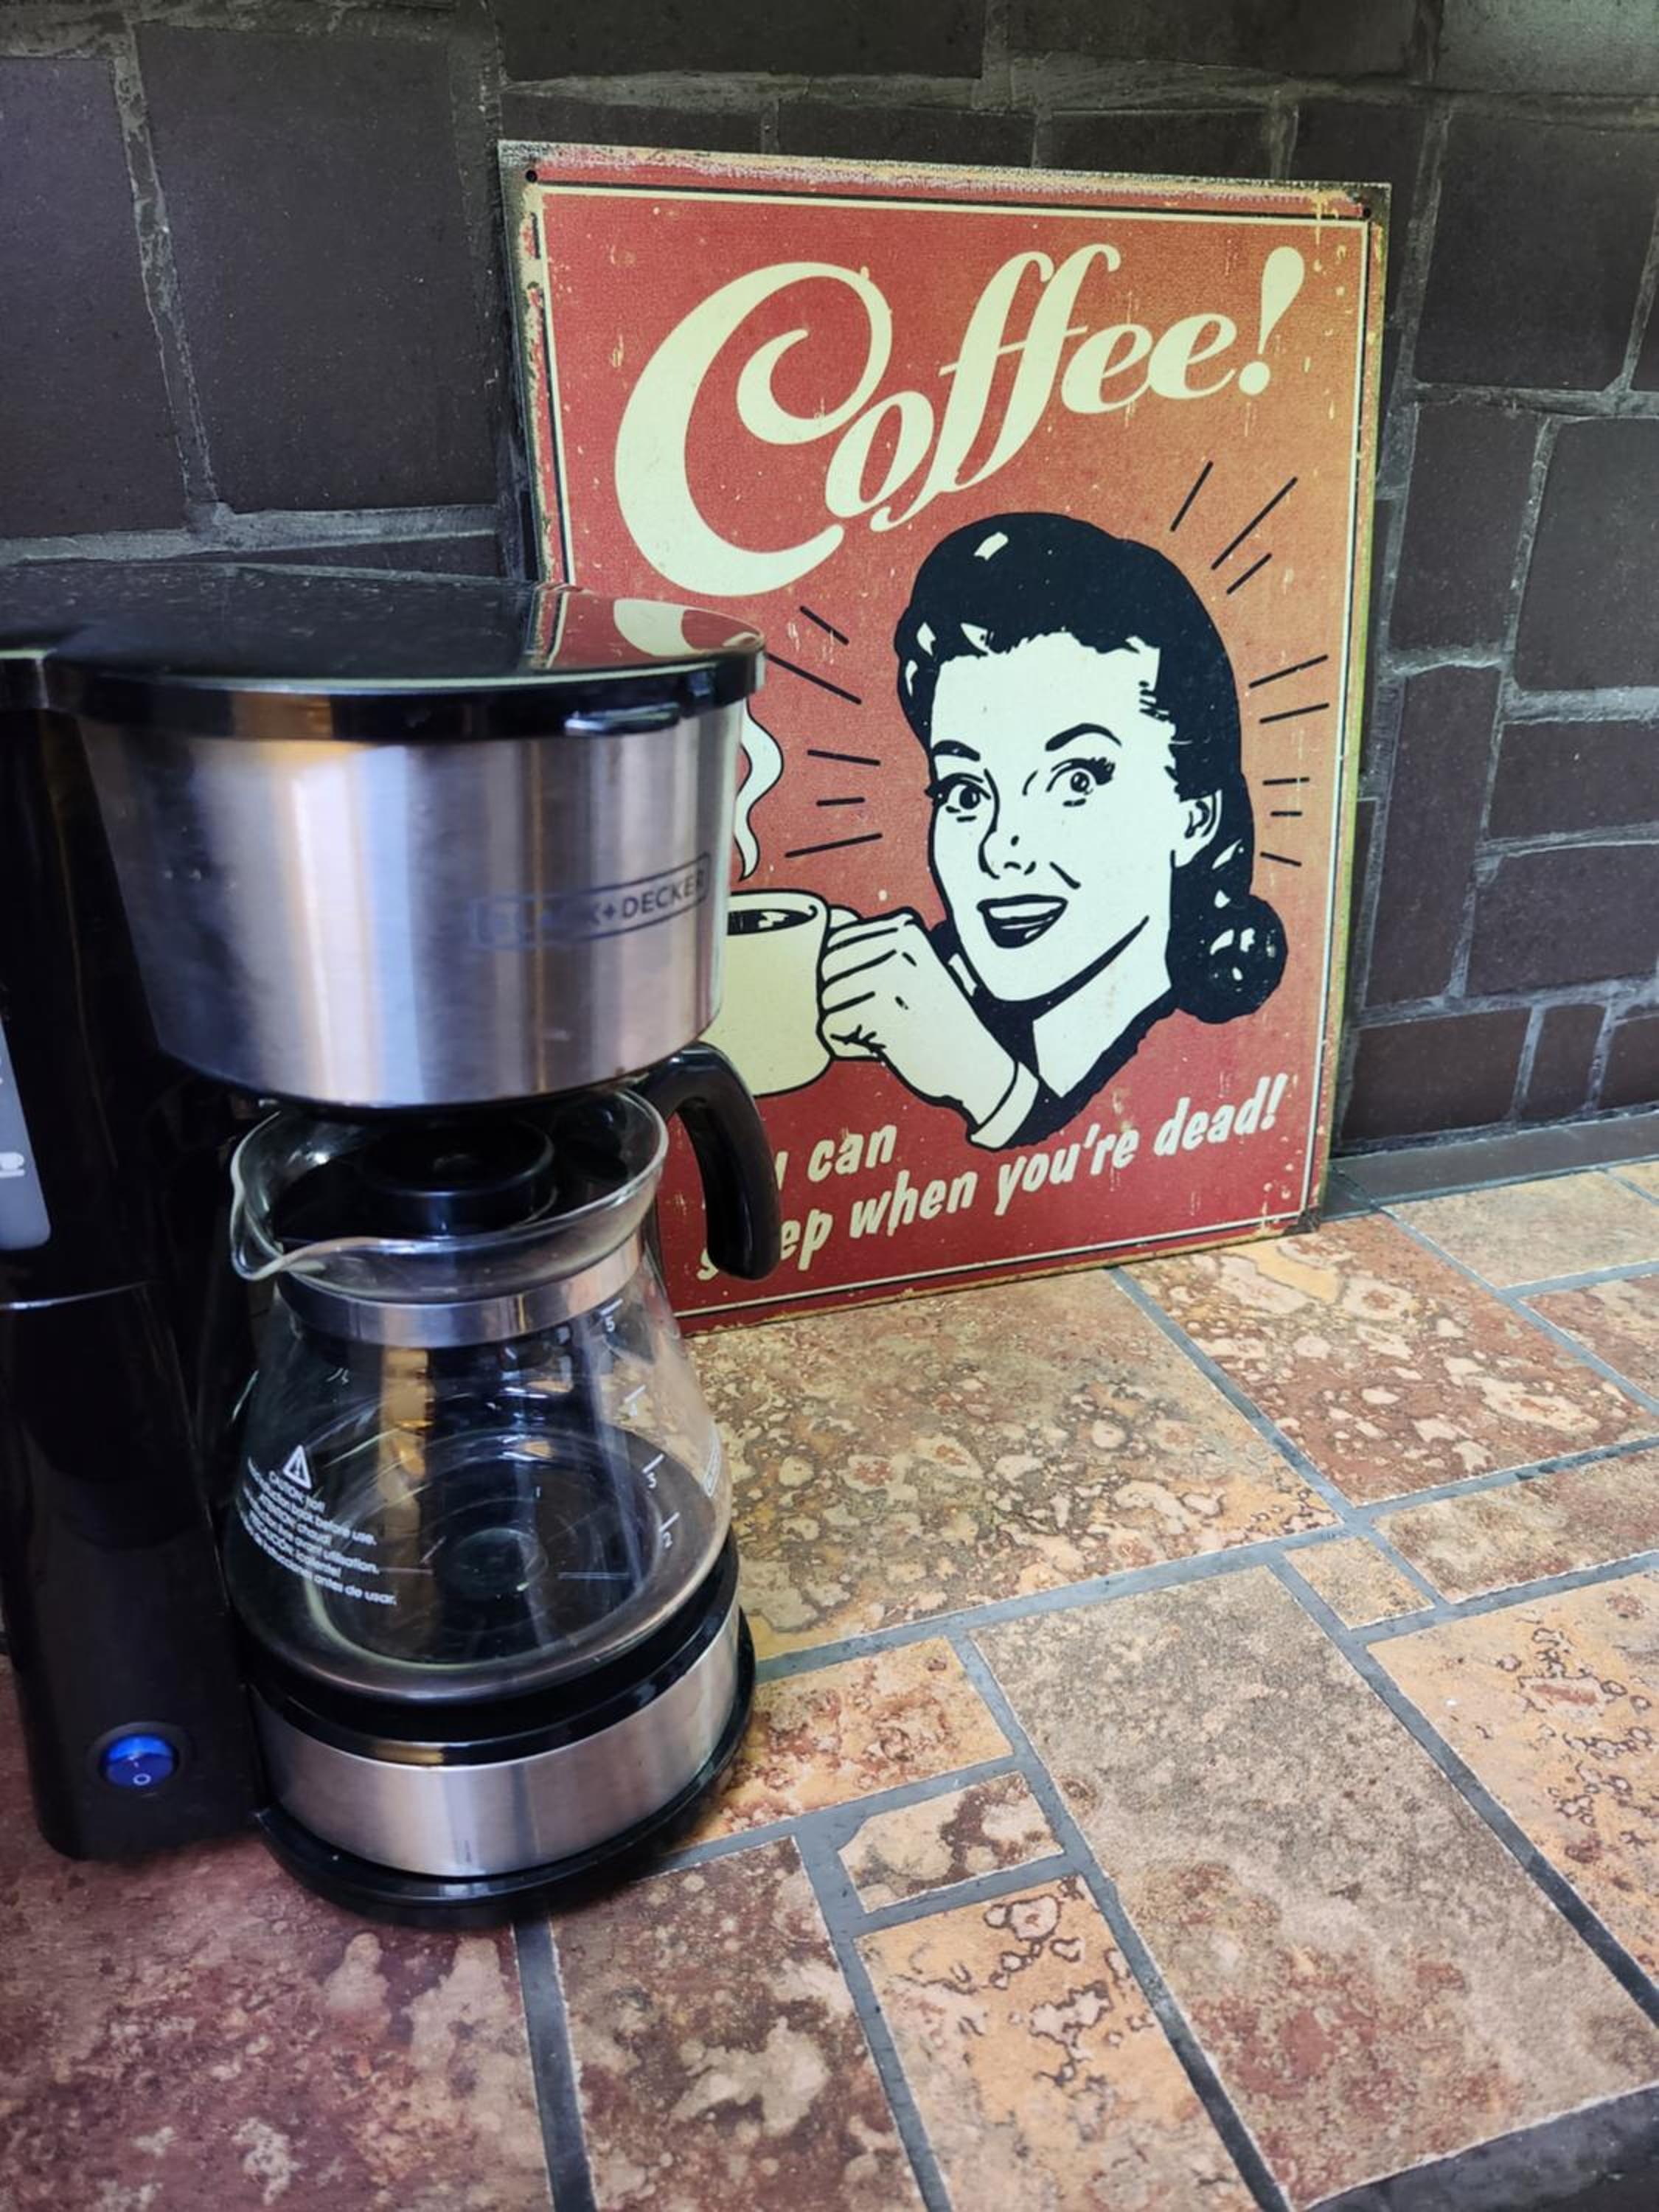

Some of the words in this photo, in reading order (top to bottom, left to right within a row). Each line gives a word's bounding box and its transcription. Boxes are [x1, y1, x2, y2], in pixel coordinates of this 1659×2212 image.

[615, 243, 1305, 597] Coffee!
[478, 869, 706, 941] K+DECKER
[696, 1208, 833, 1281] sep
[849, 1170, 977, 1238] when
[995, 1122, 1140, 1216] you're
[1153, 1074, 1288, 1156] dead!
[807, 1124, 897, 1182] can
